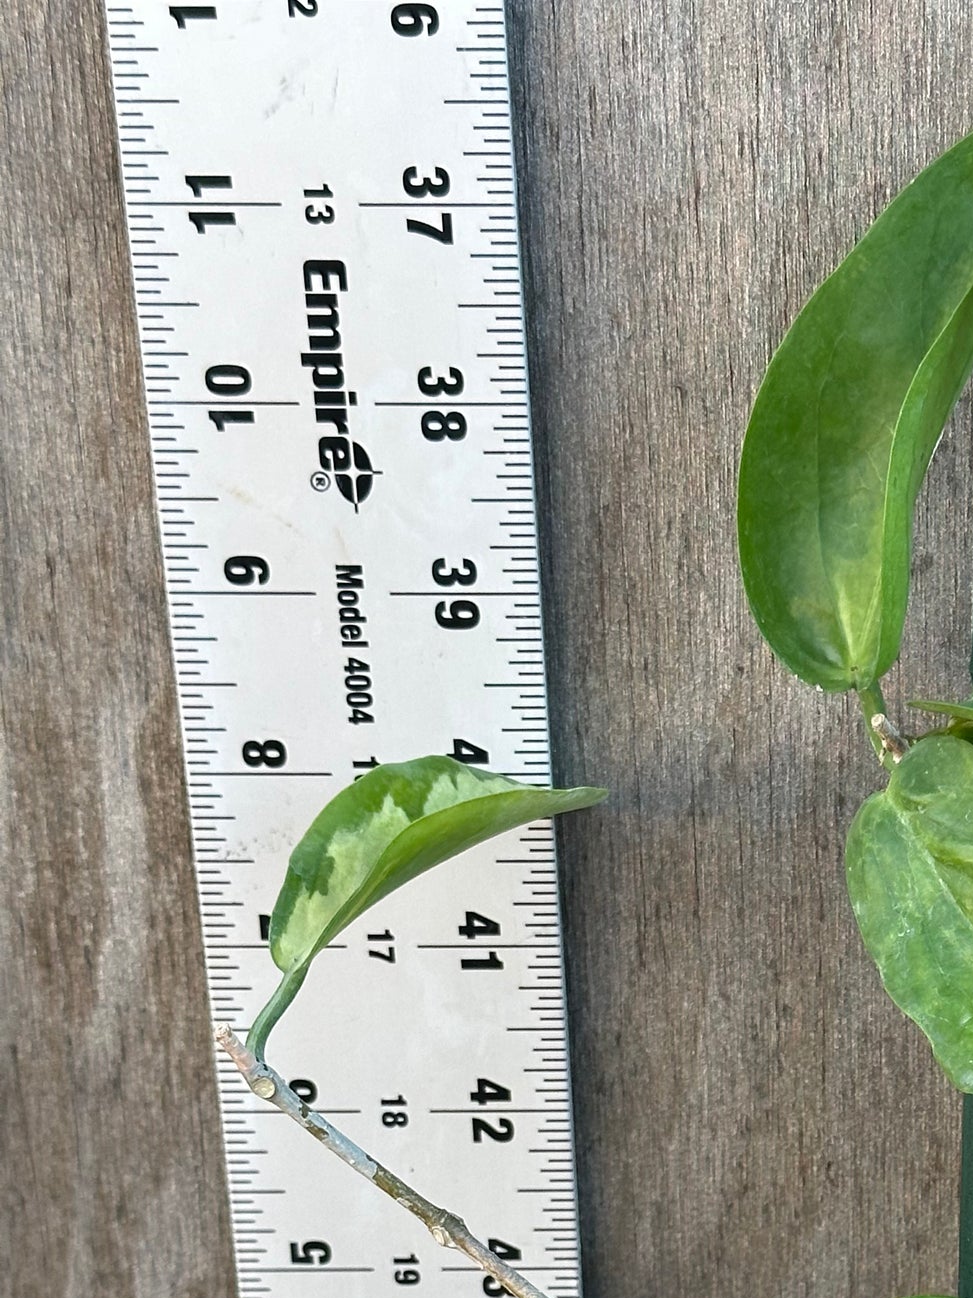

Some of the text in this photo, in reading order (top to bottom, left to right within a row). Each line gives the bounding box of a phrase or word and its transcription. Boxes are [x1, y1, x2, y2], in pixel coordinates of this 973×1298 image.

[390, 2, 440, 37] 6
[184, 174, 237, 235] 11
[303, 183, 335, 226] 13
[402, 165, 454, 246] 37
[300, 258, 358, 474] Empire
[204, 364, 256, 433] 10
[417, 366, 468, 442] 38
[223, 555, 271, 586] 9
[431, 557, 481, 631] 39
[334, 563, 375, 726] Model 4004
[241, 739, 288, 769] 8
[366, 928, 397, 965] 17
[457, 910, 505, 971] 41
[380, 1094, 409, 1129] 18
[469, 1077, 515, 1144] 42
[289, 1240, 333, 1266] 5
[393, 1253, 421, 1288] 19
